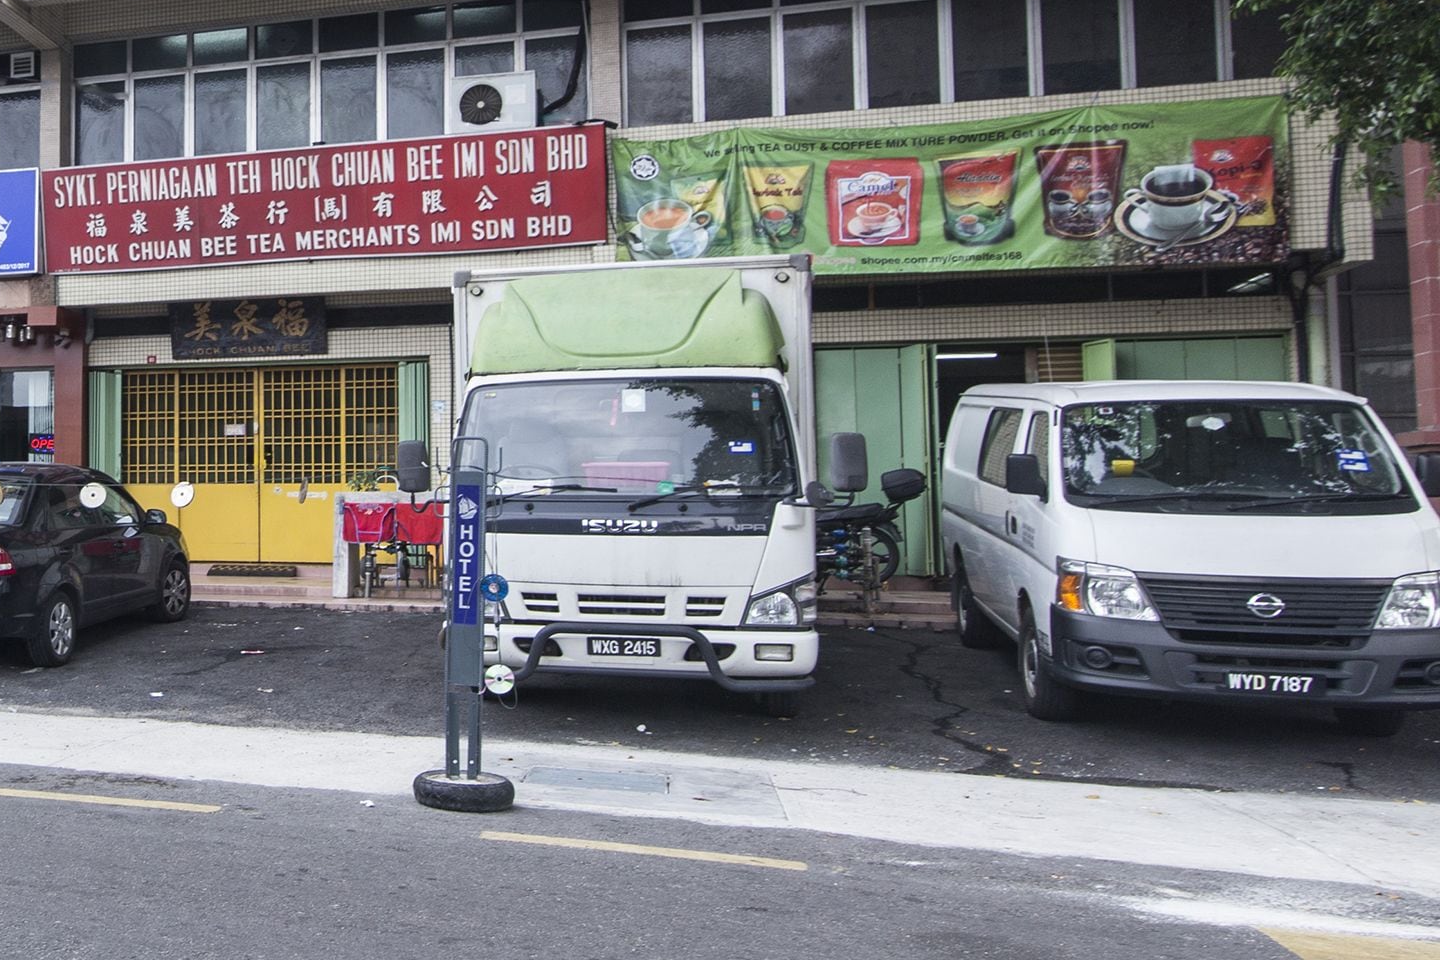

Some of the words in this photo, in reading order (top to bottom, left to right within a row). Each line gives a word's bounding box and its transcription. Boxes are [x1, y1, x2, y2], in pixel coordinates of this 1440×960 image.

[759, 143, 781, 152] TEA
[785, 142, 817, 152] DUST
[820, 141, 829, 152] &
[832, 140, 882, 151] COFFEE
[885, 139, 909, 149] MIX
[1012, 128, 1034, 140] Get
[1049, 127, 1065, 136] on
[1068, 122, 1119, 135] Shopee
[1121, 119, 1155, 130] now!
[54, 172, 102, 208] SYKT.
[106, 162, 218, 205] PERNIAGAAN
[226, 158, 262, 195] TEH
[271, 154, 321, 192] HOCK
[331, 147, 396, 187] CHUAN
[406, 144, 444, 182] BEE
[495, 136, 536, 176] SDN
[546, 133, 589, 172] BHD
[70, 243, 120, 266] HOCK
[128, 238, 192, 262] CHUAN
[200, 235, 238, 258] BEE
[246, 232, 287, 255] TEA
[295, 223, 421, 252] MERCHANTS
[471, 217, 516, 241] SDN
[526, 214, 573, 238] BHD
[230, 345, 276, 355] CHUAN
[581, 518, 659, 534] ISUZU
[727, 523, 768, 532] NPR
[458, 524, 475, 610] HOTEL
[591, 639, 620, 655] WXG
[623, 640, 657, 656] 2415
[1228, 673, 1266, 690] WYD
[1268, 675, 1313, 693] 7187
